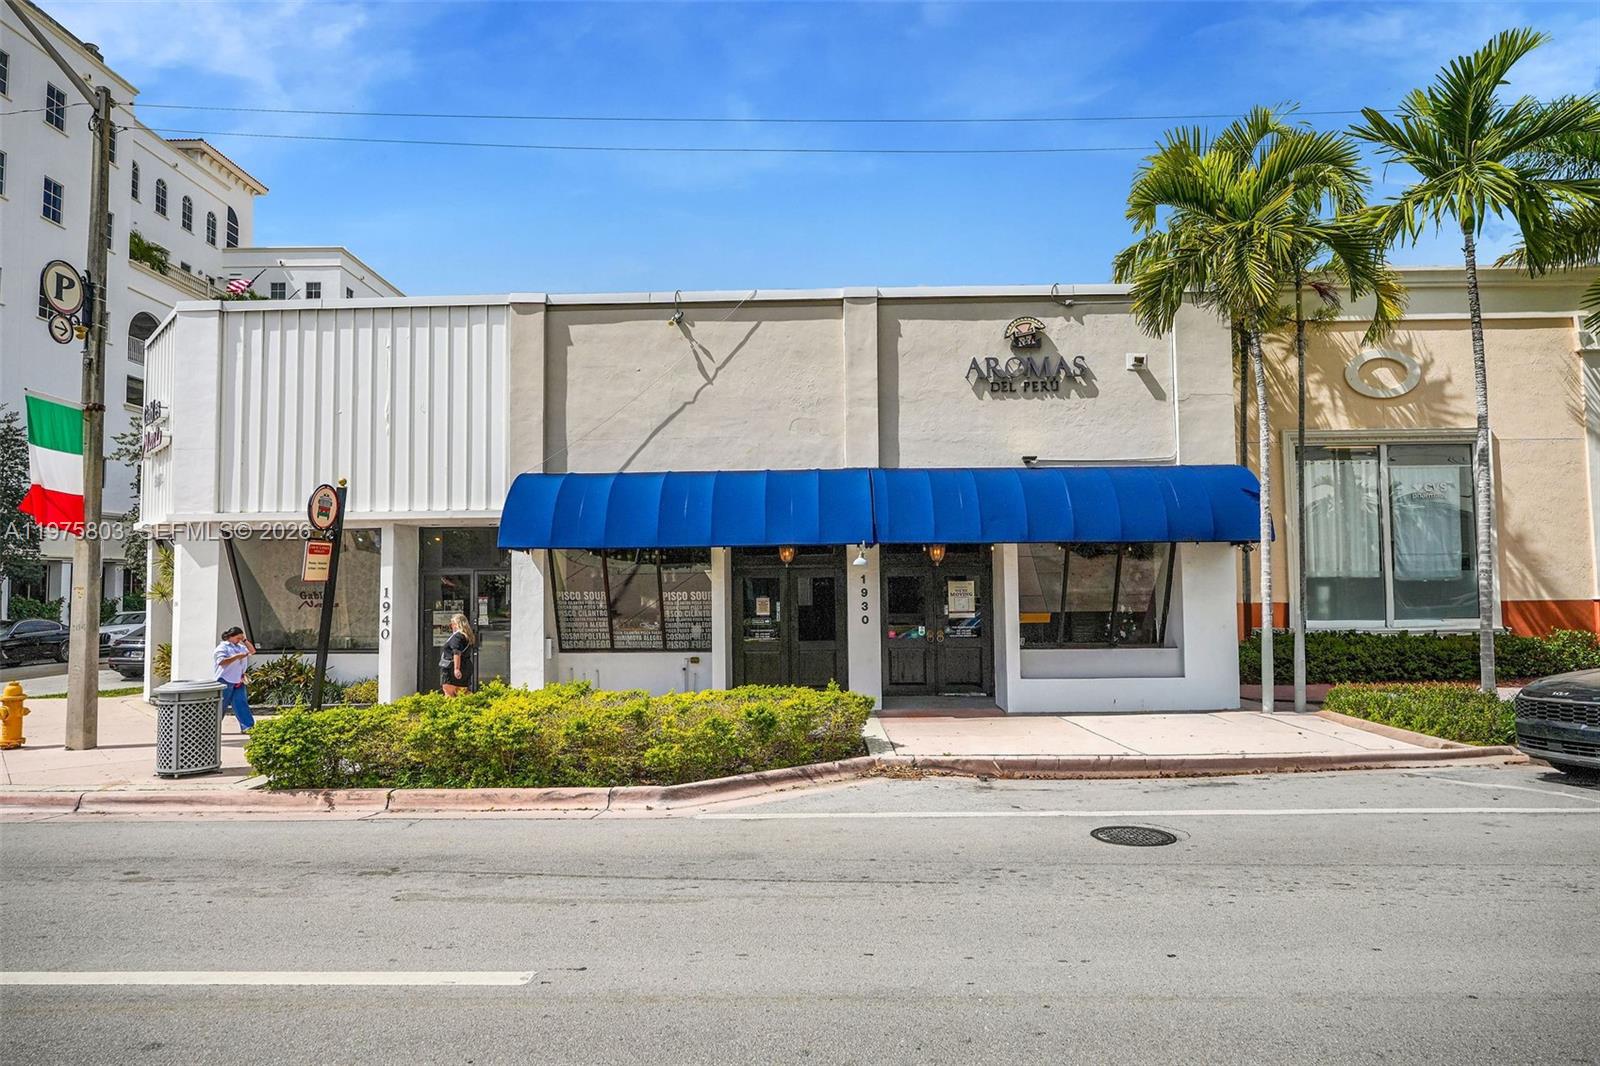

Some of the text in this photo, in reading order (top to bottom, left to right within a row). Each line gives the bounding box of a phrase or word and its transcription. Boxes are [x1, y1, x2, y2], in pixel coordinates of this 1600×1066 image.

[54, 271, 76, 302] P
[965, 355, 1086, 378] AROMAS
[990, 381, 1016, 393] DEL
[557, 591, 607, 601] PISCO SOUR
[663, 591, 688, 601] PISCO
[860, 574, 870, 625] 1930
[380, 587, 391, 640] 1940
